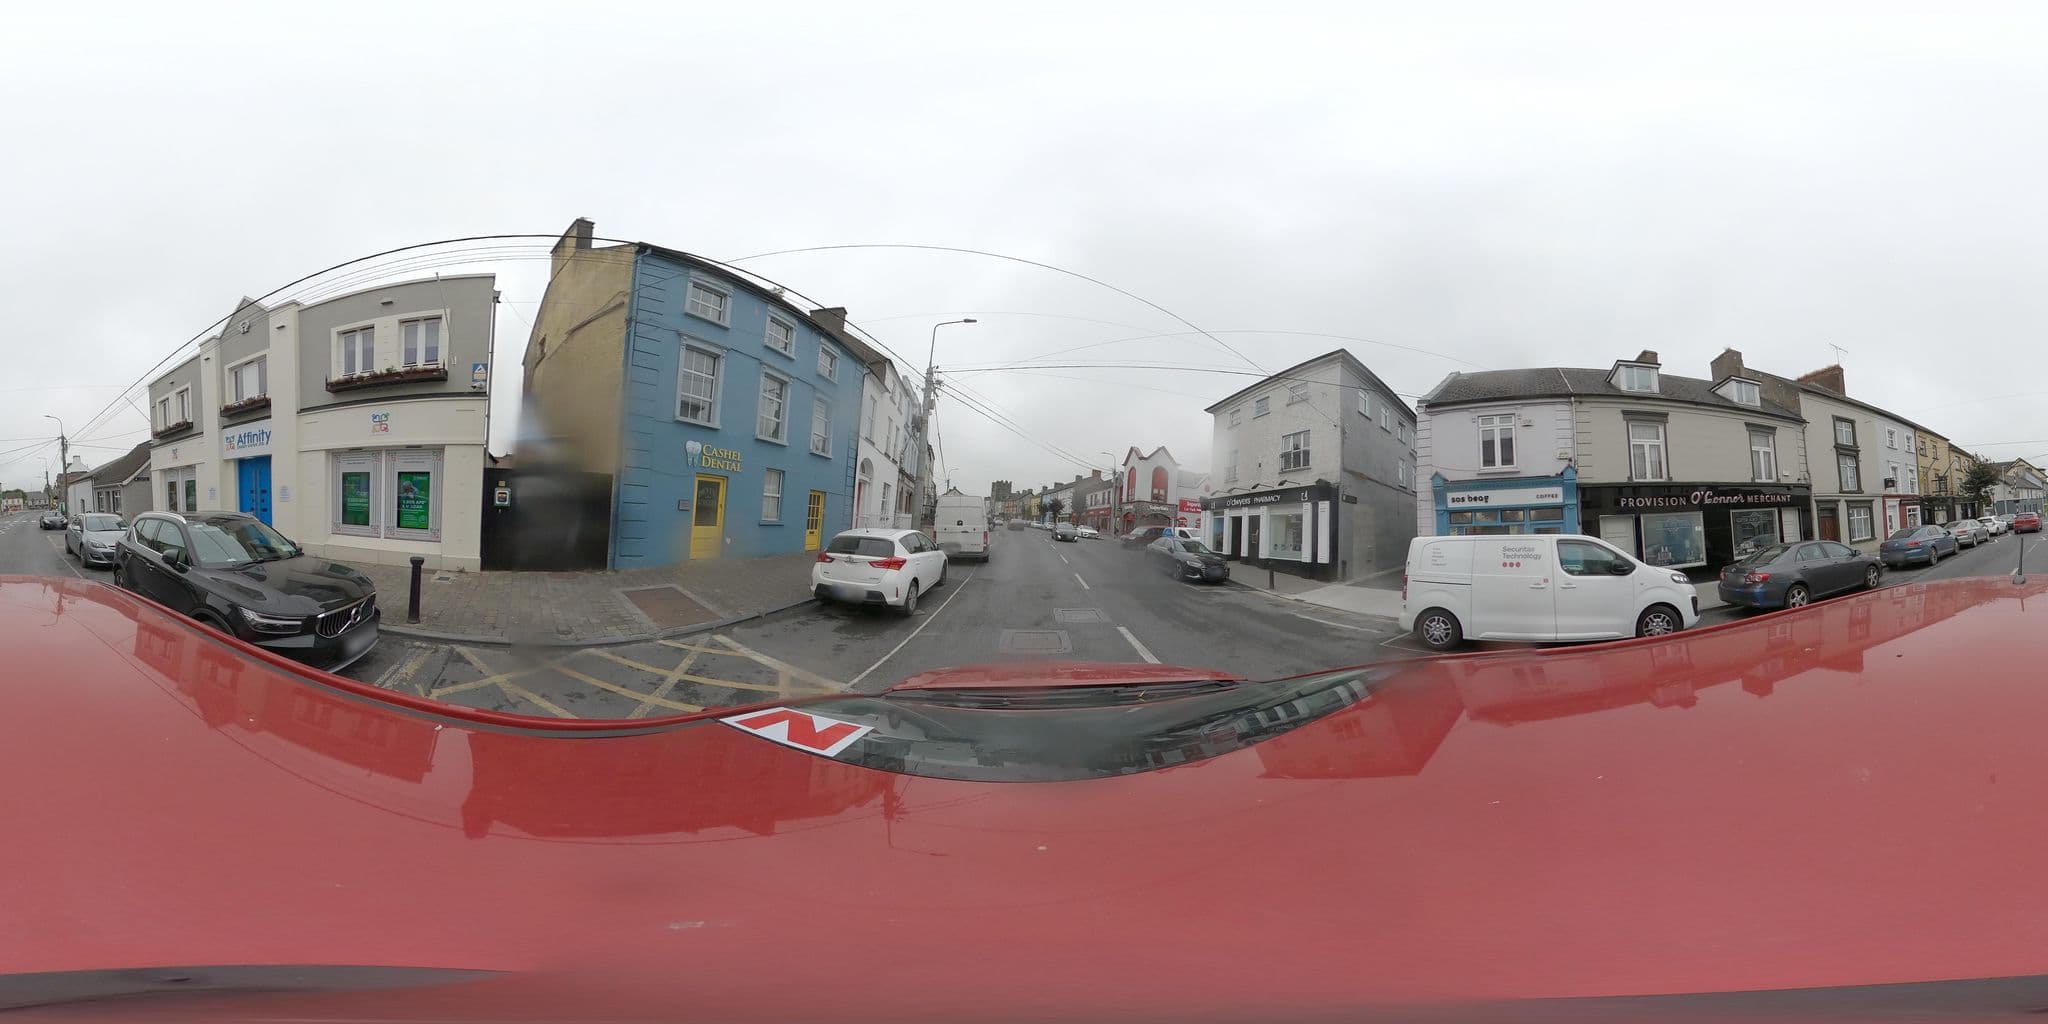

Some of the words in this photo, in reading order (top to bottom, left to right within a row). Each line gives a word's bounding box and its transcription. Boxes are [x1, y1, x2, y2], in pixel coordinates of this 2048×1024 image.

[237, 429, 272, 446] Affinity
[1253, 495, 1281, 504] PHARMACY
[1620, 497, 1687, 508] PROVISION
[1690, 490, 1746, 505] O'Connor
[1746, 494, 1792, 503] MERCHANT
[1502, 553, 1542, 561] Technology
